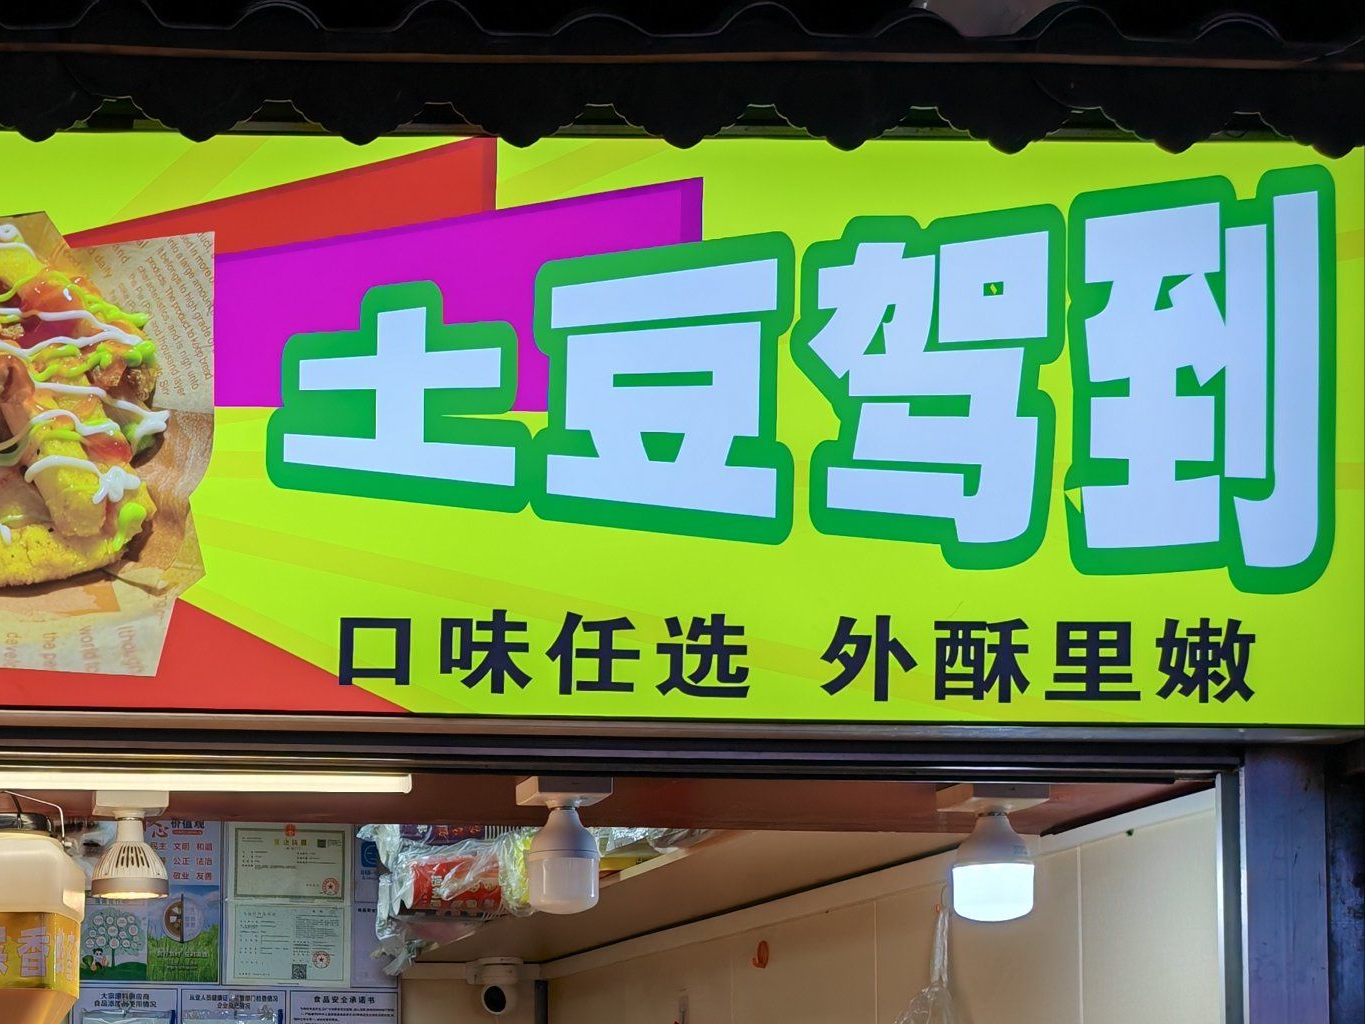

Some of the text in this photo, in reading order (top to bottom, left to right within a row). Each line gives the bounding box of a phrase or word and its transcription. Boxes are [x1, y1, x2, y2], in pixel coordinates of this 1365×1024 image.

[282, 190, 1320, 567] 土豆驾到
[337, 609, 1257, 704] 口味任选 外酥里嫩
